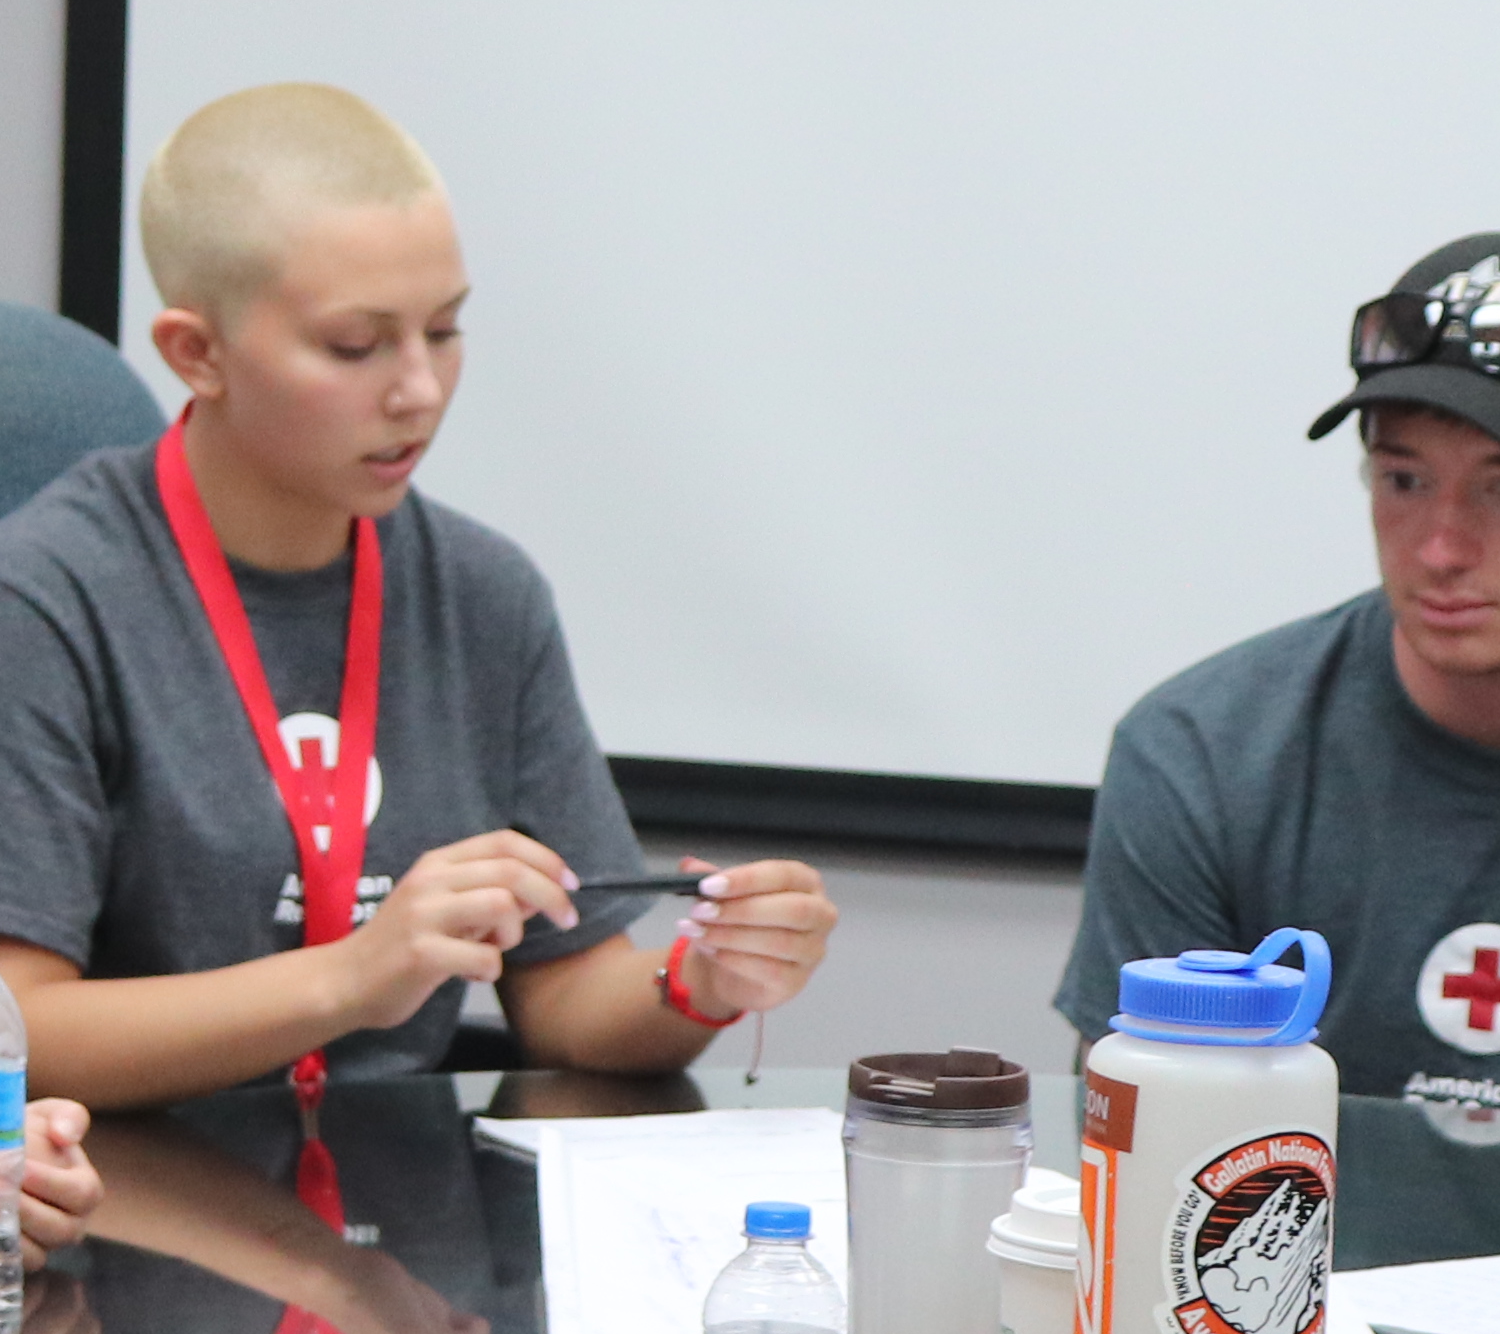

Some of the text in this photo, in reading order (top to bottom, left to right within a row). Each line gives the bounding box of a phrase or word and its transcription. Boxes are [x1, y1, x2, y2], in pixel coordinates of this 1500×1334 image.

[1203, 1147, 1268, 1195] Gallatin
[1268, 1138, 1323, 1169] National
[1176, 1205, 1191, 1228] YOU
[1171, 1229, 1186, 1264] BEFORE
